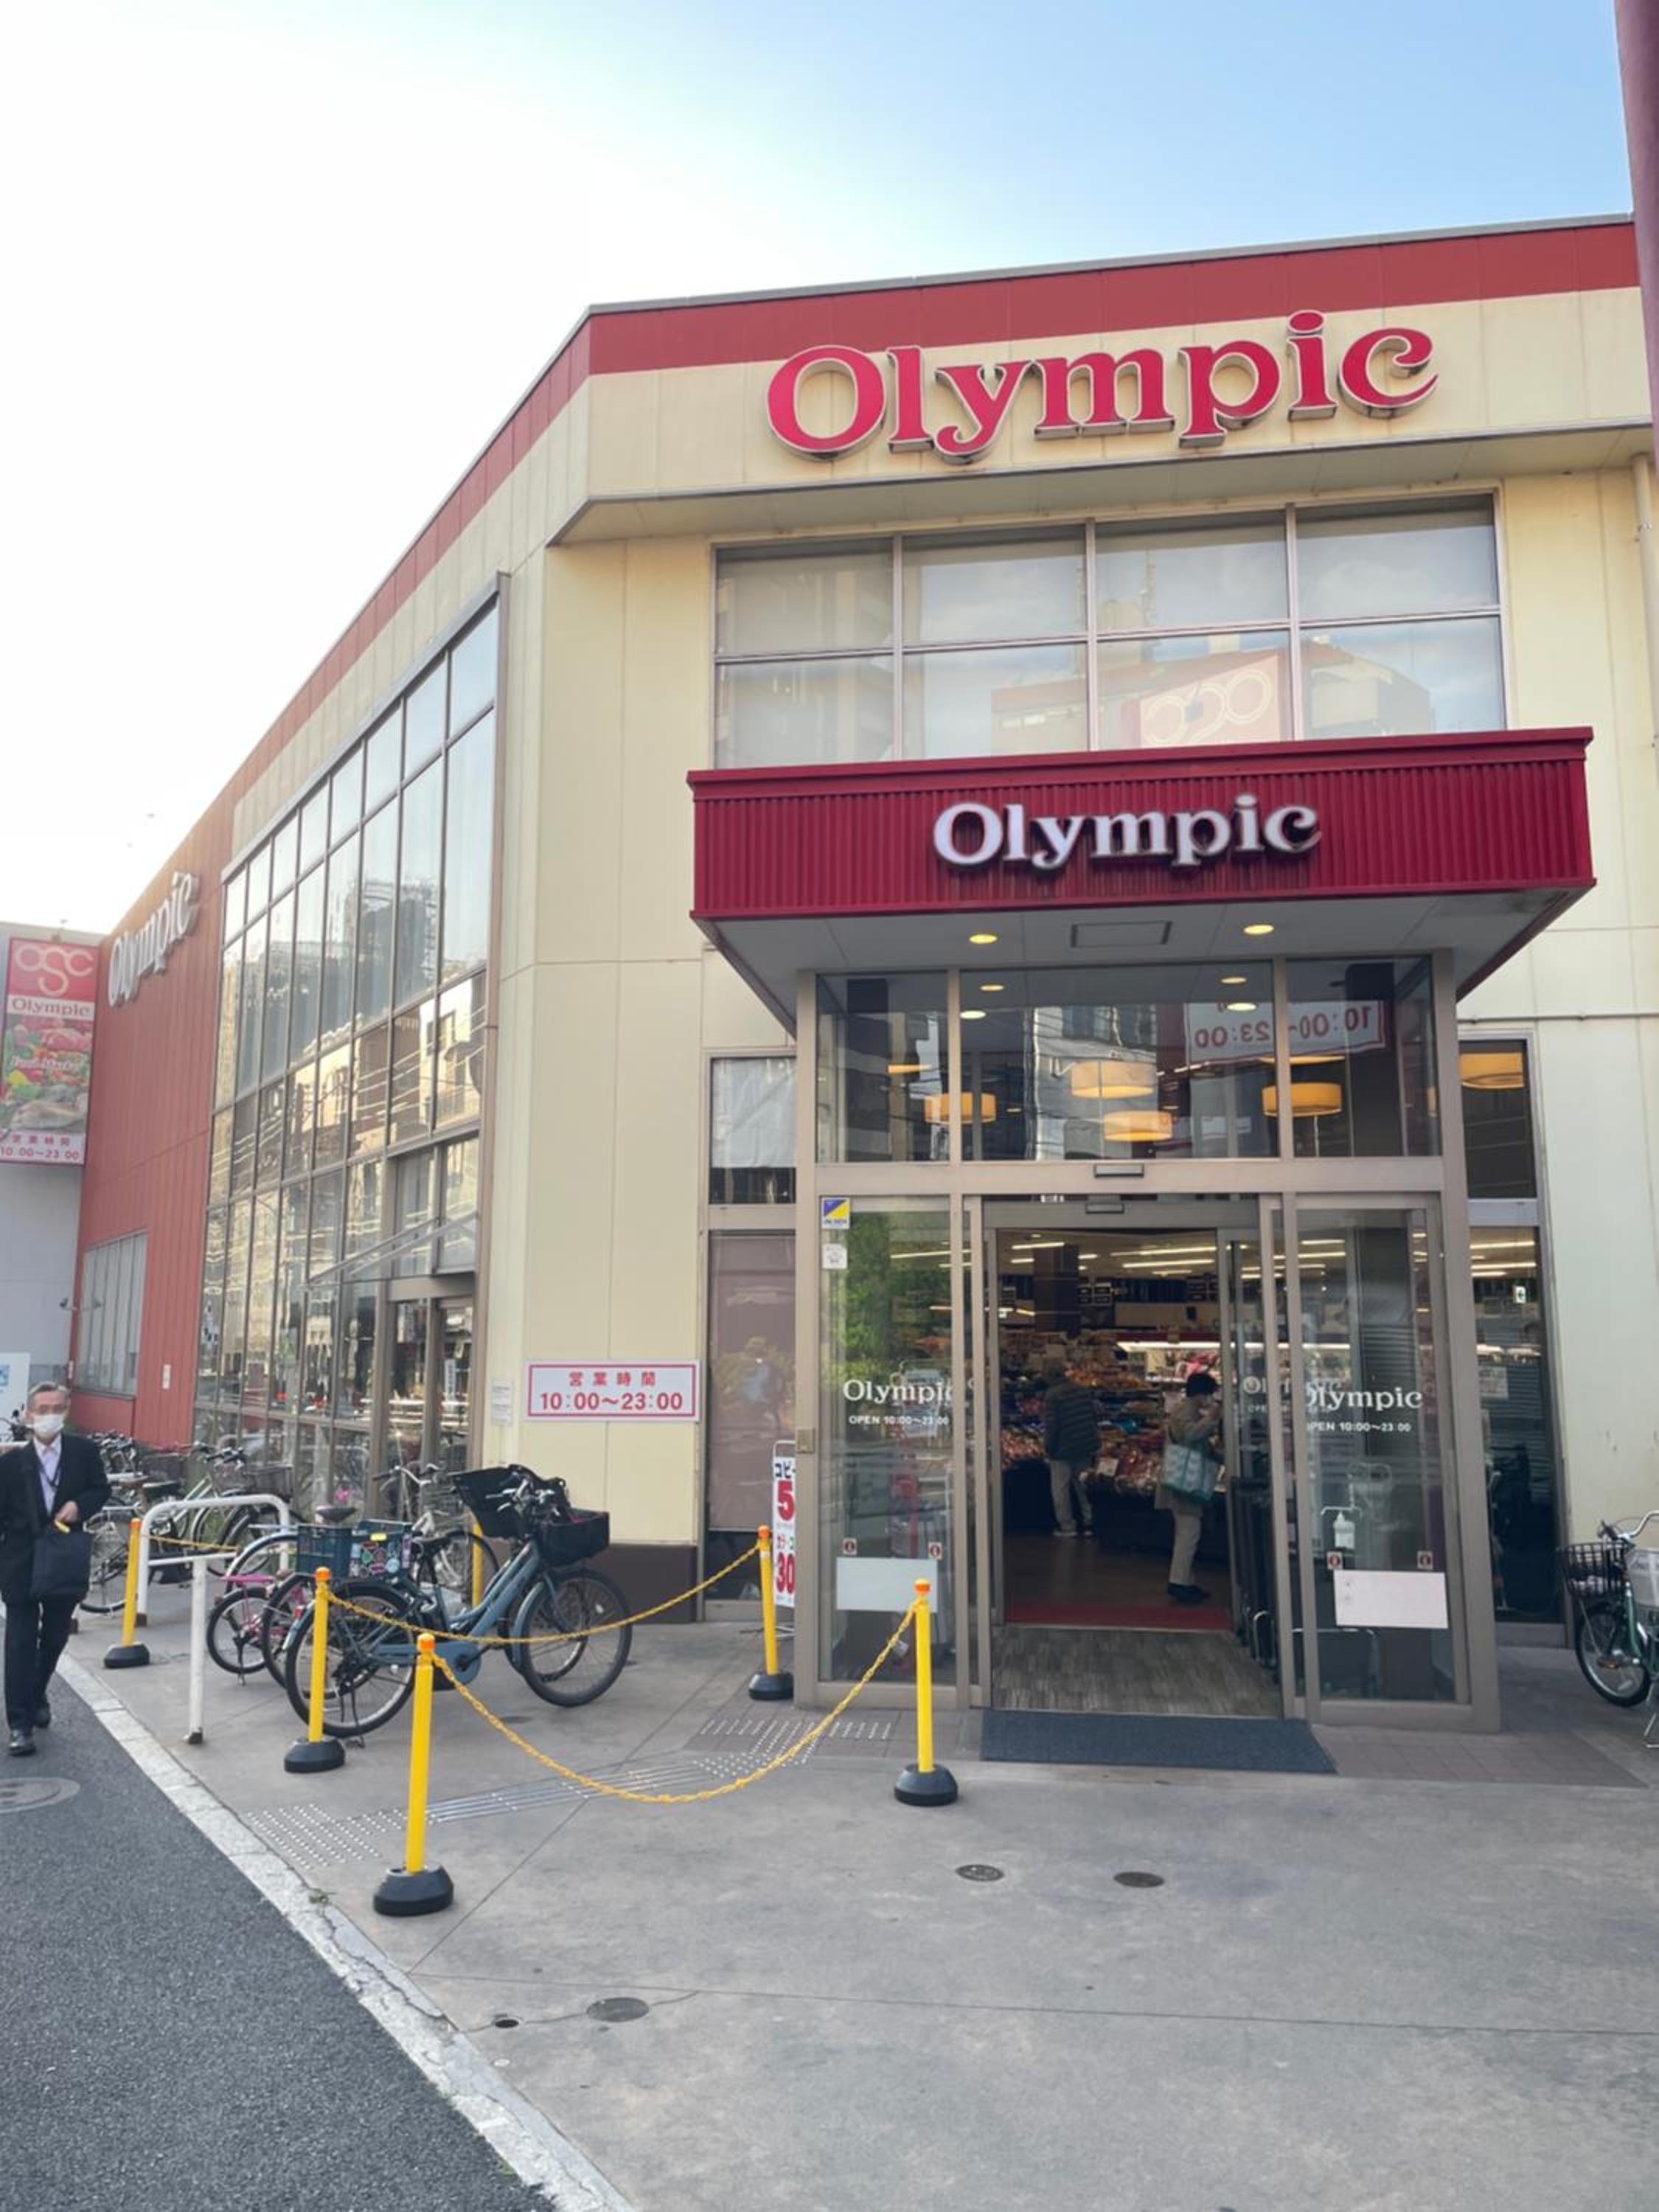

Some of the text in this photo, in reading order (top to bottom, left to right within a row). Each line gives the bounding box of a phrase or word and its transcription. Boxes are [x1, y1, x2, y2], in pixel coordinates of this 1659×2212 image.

[766, 310, 1439, 464] Olympic
[932, 793, 1322, 869] Olympic
[108, 872, 200, 1006] Olympic
[12, 997, 91, 1016] Olympic
[568, 1371, 655, 1387] 営業時間
[849, 1415, 880, 1425] OPEN
[1307, 1422, 1335, 1432] PEN
[778, 1480, 795, 1521] 5
[776, 1551, 795, 1594] 30
